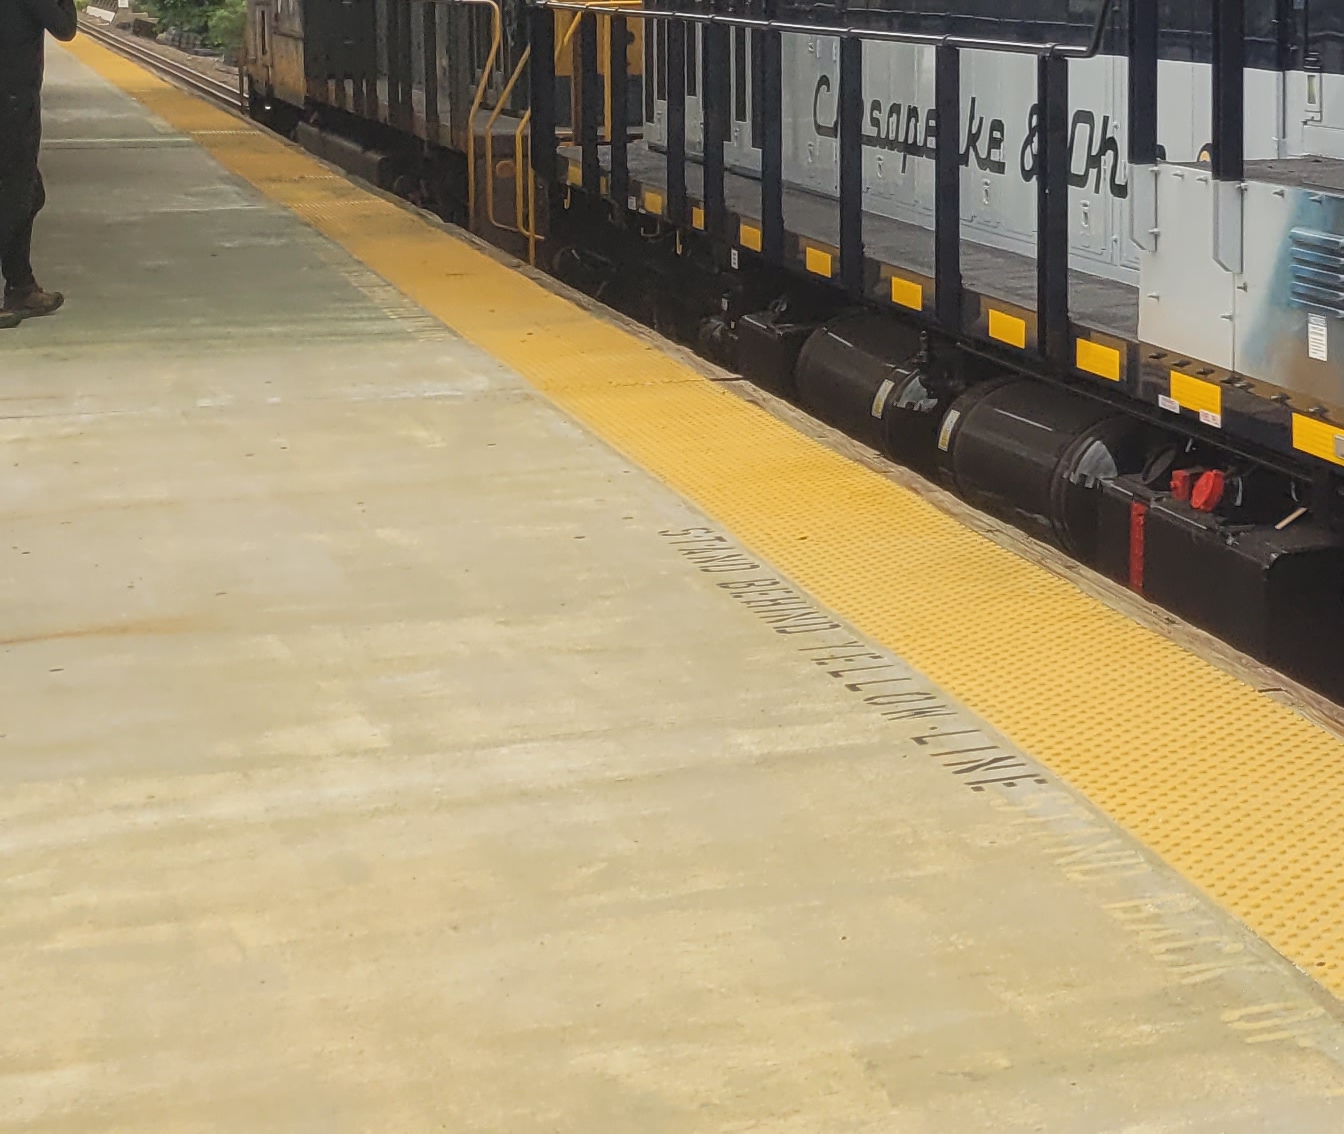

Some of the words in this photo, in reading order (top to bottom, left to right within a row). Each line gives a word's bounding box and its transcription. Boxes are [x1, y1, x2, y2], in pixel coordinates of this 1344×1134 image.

[813, 74, 1007, 176] Csapeke
[658, 527, 760, 572] STAND
[716, 578, 842, 635] BEHIND
[797, 640, 958, 721] YELLOW
[909, 729, 1049, 792] LINE
